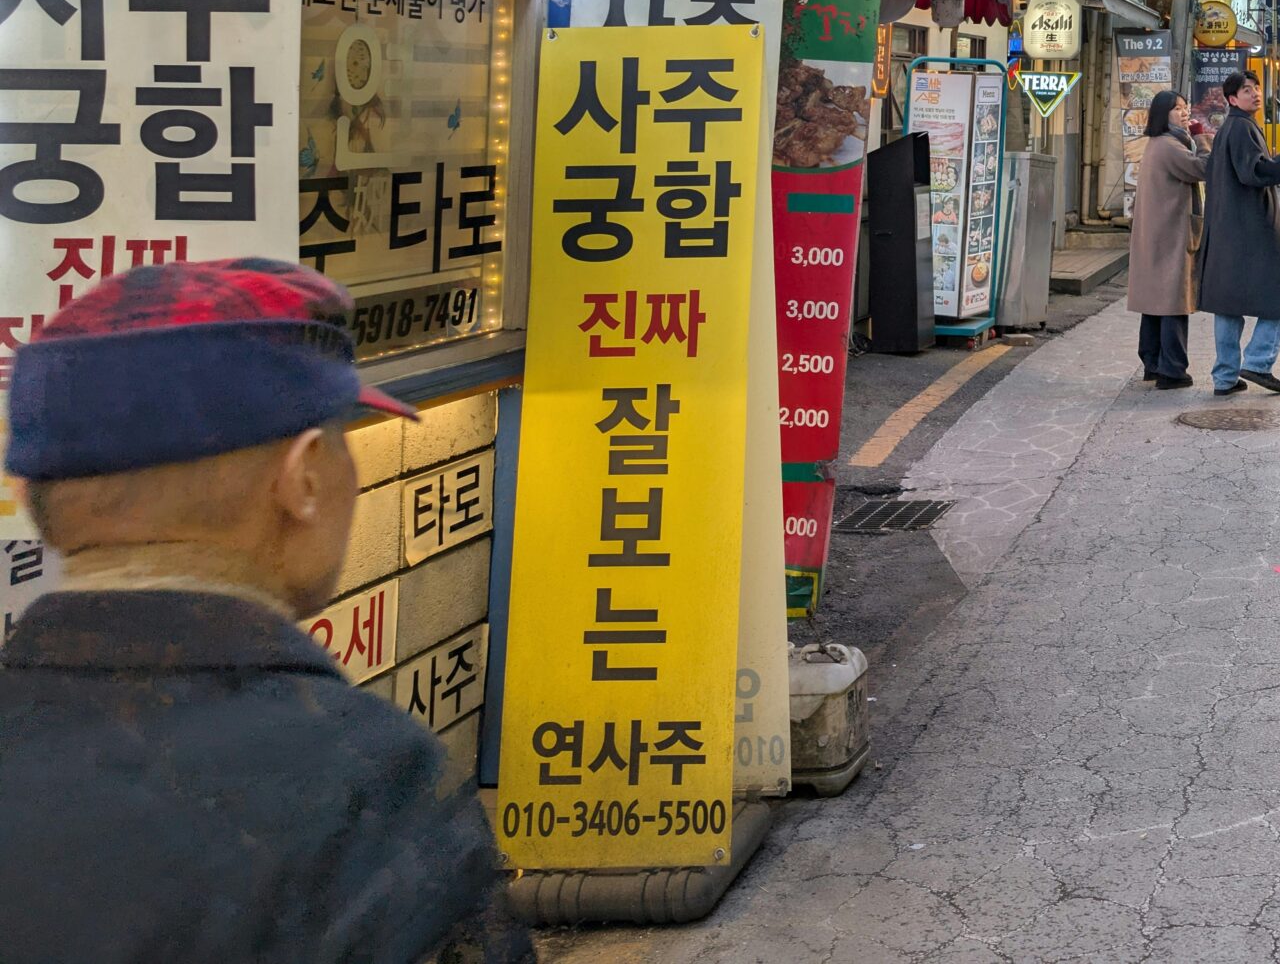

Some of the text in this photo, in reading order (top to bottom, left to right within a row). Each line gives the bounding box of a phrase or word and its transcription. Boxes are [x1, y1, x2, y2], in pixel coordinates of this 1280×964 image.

[1031, 15, 1073, 31] Asahi
[1123, 39, 1163, 50] The 9.2
[553, 57, 742, 154] 사주
[1022, 74, 1068, 91] TERRA
[0, 64, 274, 225] 궁합
[389, 162, 502, 274] 타로
[553, 160, 742, 263] 궁합
[791, 247, 844, 268] 3,000
[578, 290, 706, 358] 진짜
[786, 299, 839, 321] 3,000
[781, 353, 834, 375] 2,500
[779, 406, 829, 430] 2,000
[413, 465, 484, 546] 타로
[583, 383, 681, 682] 잘보는
[407, 640, 479, 721] 사주
[531, 719, 707, 787] 연사주
[502, 798, 727, 837] 010-3406-5500
